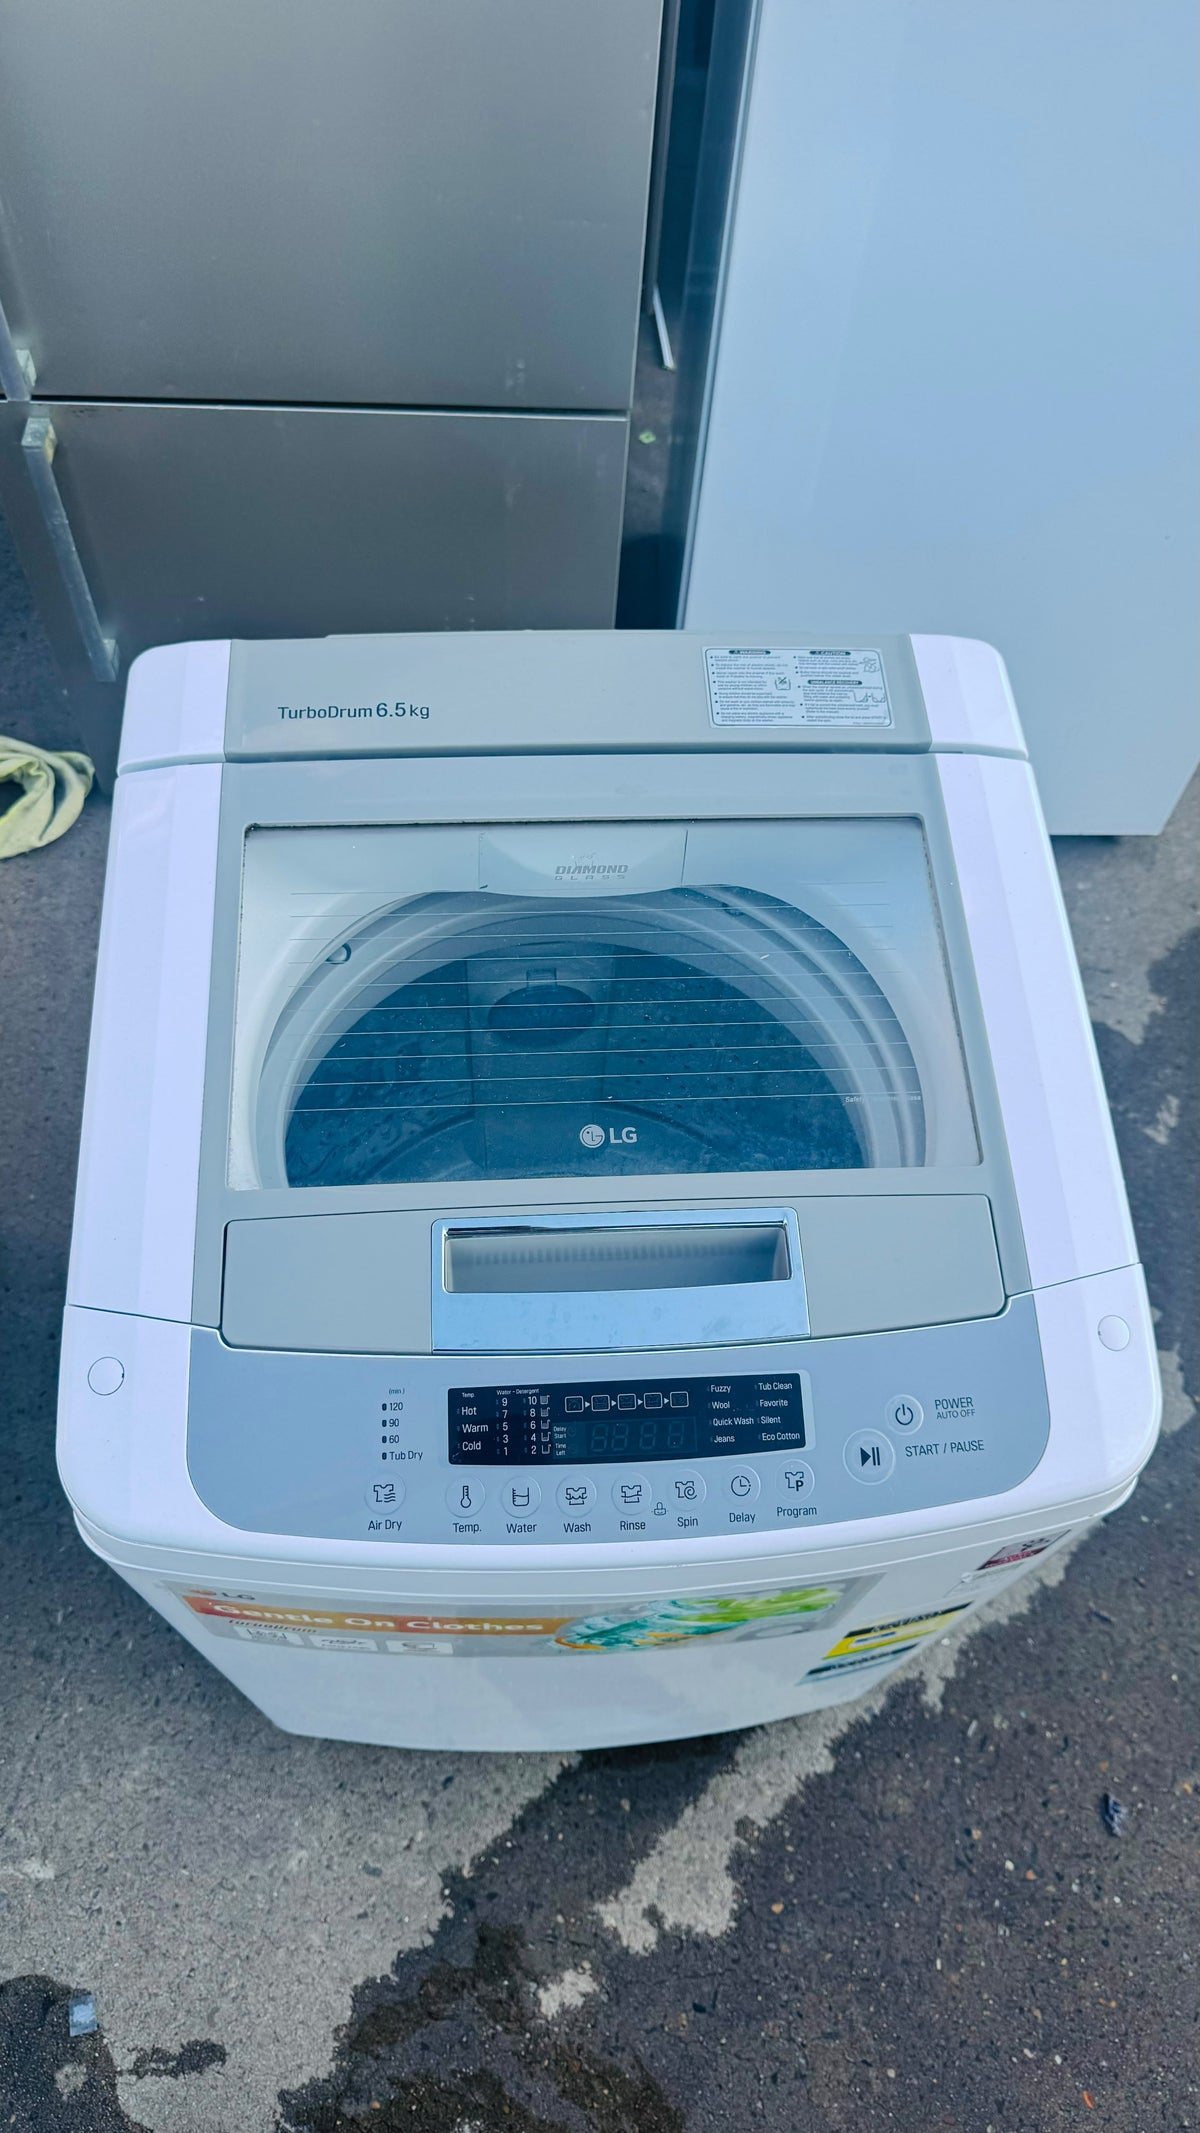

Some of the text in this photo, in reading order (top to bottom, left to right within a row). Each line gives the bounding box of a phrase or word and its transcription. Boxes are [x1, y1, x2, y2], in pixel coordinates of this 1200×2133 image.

[278, 705, 372, 719] TurboDrum
[555, 864, 629, 875] DIAMOND
[609, 1126, 638, 1144] LG
[710, 1384, 731, 1393] Fuzzy
[758, 1382, 793, 1390] Tub Clean
[502, 1396, 538, 1406] 9 10
[712, 1401, 730, 1409] Wool
[760, 1399, 789, 1407] Favorite
[934, 1396, 974, 1410] POWER
[389, 1402, 403, 1411] 120
[461, 1406, 477, 1416] Hot
[502, 1408, 536, 1419] 7 8
[936, 1408, 976, 1420] AUTO OFF
[389, 1418, 399, 1427] 90
[712, 1417, 754, 1426] Quick Wash
[760, 1415, 781, 1424] Silent
[462, 1423, 489, 1433] Warm
[502, 1421, 536, 1431] 5 6
[389, 1435, 399, 1444] 60
[503, 1433, 537, 1443] 3 4
[713, 1435, 735, 1443] Jeans
[762, 1431, 800, 1441] Eco Cotton
[462, 1441, 482, 1451] Cold
[504, 1446, 537, 1456] 1 2
[905, 1443, 940, 1457] START
[950, 1439, 985, 1453] PAUSE
[389, 1451, 423, 1461] Tub Dry
[777, 1506, 817, 1518] Program
[677, 1516, 698, 1529] Spin
[729, 1512, 755, 1524] Delay
[368, 1519, 402, 1531] Air Dry
[453, 1522, 482, 1534] Temp.
[506, 1523, 537, 1533] Water
[563, 1522, 592, 1533] Wash
[620, 1520, 646, 1531] Rinse
[213, 1604, 543, 1631] Gentle On Clothes
